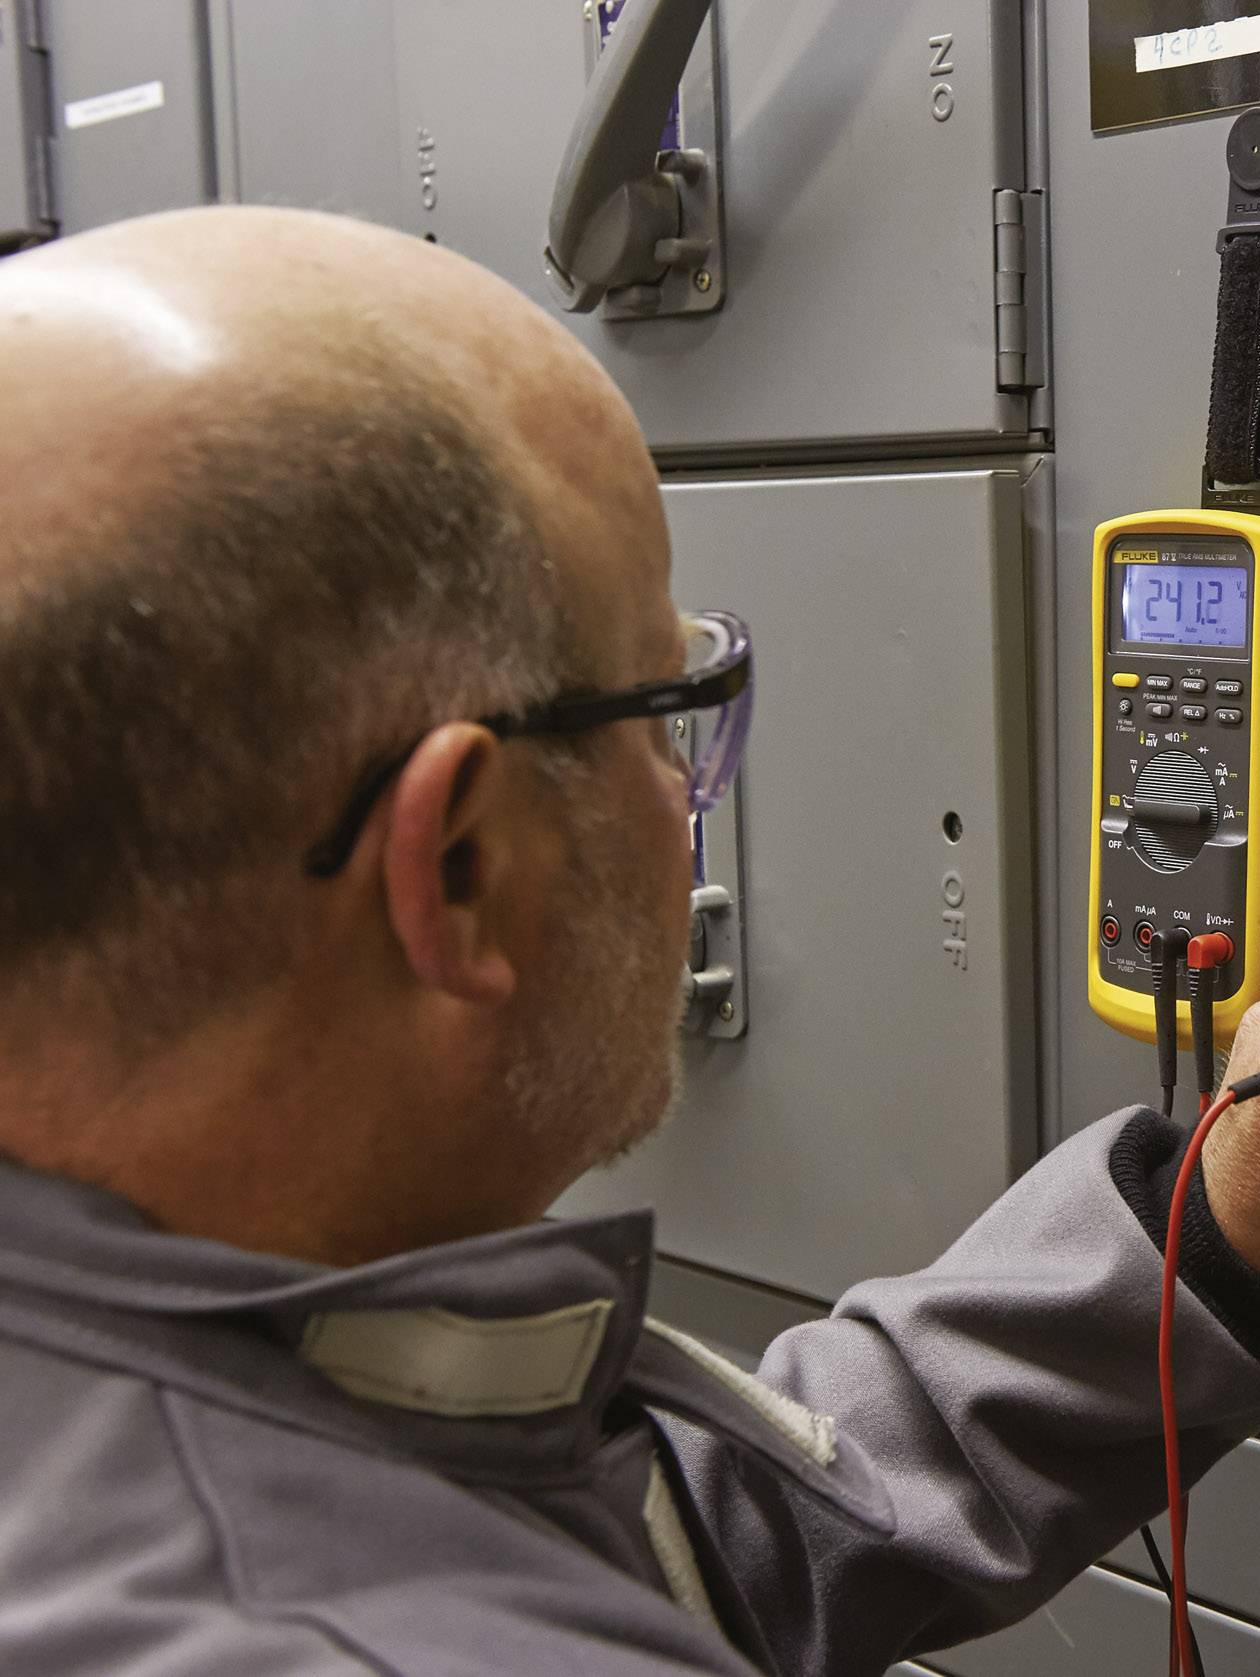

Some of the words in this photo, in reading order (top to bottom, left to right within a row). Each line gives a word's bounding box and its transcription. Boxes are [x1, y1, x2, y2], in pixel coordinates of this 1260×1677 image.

[928, 33, 954, 122] ON
[1121, 552, 1156, 561] FLUKE
[1183, 681, 1201, 689] RANGE
[1215, 767, 1228, 776] mA
[1108, 840, 1122, 849] OFF
[1107, 899, 1113, 908] A
[1173, 910, 1191, 920] COM
[1125, 959, 1137, 967] MAX
[1117, 964, 1135, 973] FUSED
